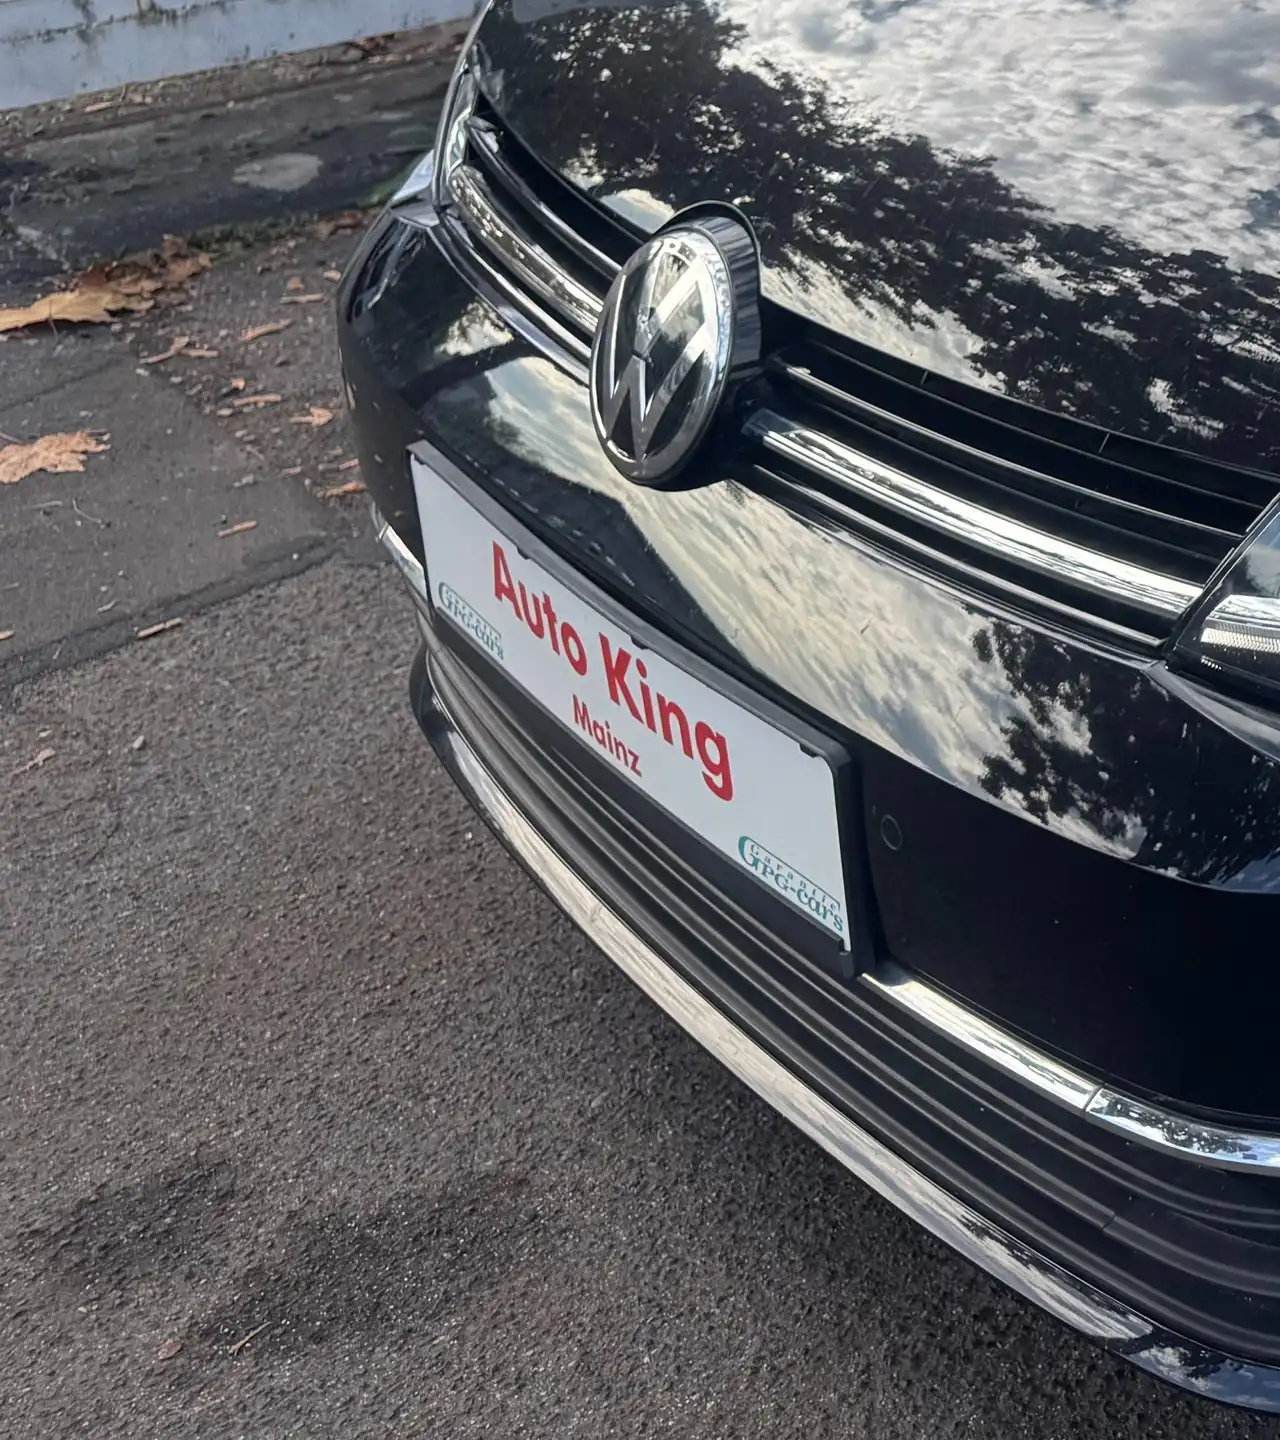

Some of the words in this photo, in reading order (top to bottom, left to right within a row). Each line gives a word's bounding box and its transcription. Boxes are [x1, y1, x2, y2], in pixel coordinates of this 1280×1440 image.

[492, 539, 588, 676] Auto
[600, 632, 734, 802] King
[572, 694, 643, 778] Mainz
